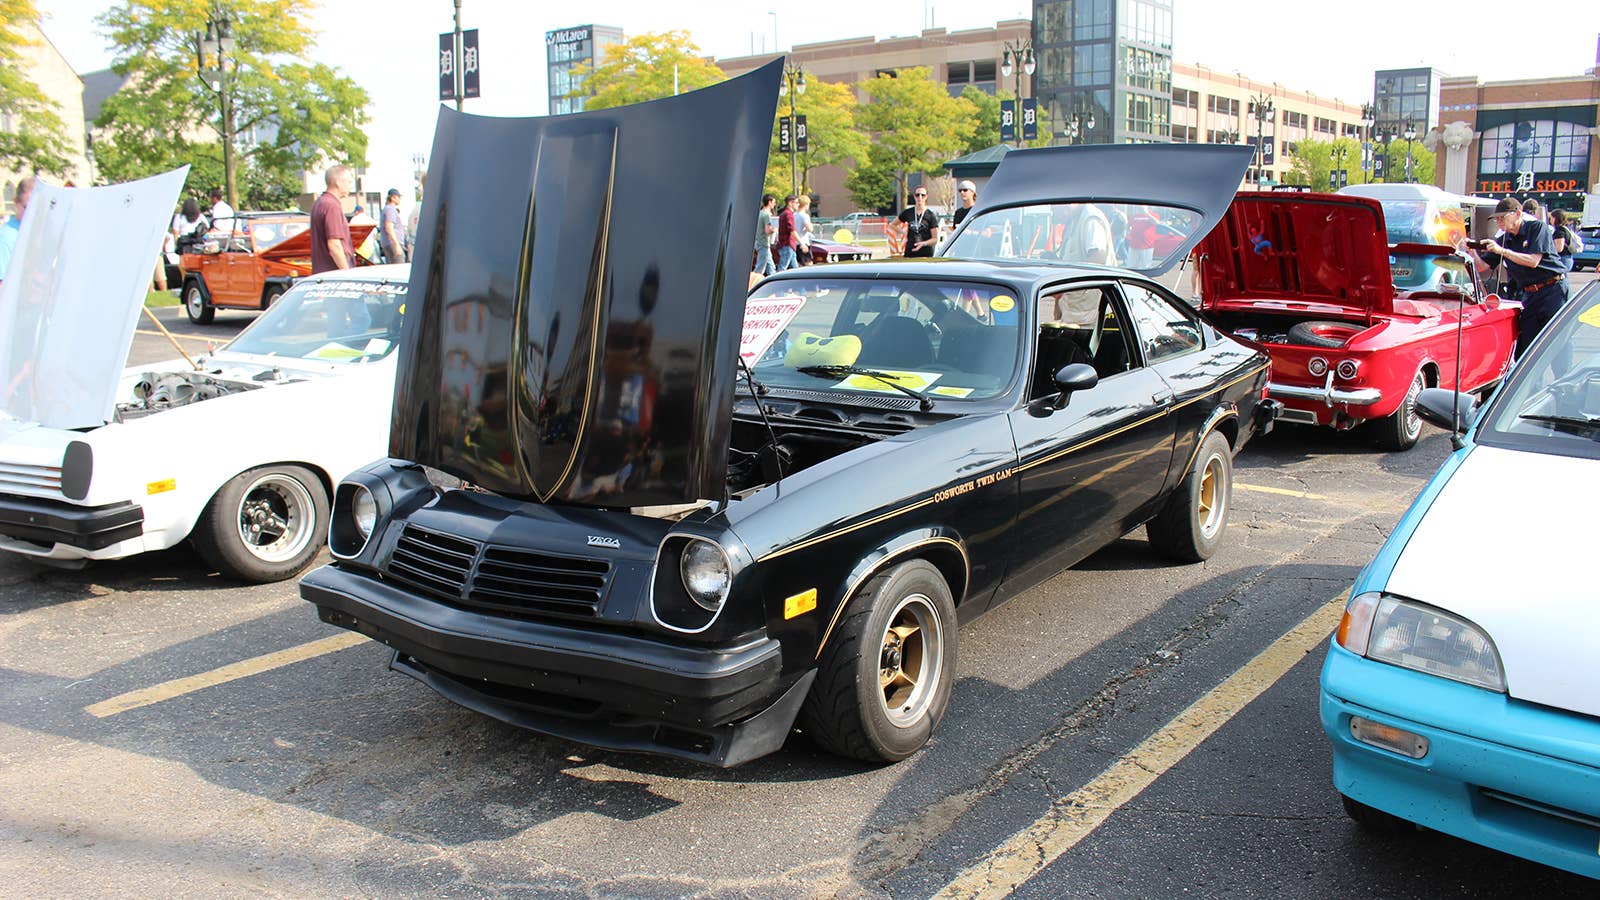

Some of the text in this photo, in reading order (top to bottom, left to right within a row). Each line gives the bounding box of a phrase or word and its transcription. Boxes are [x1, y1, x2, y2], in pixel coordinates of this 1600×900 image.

[556, 30, 588, 43] McLaren
[781, 130, 789, 145] 3
[1480, 181, 1511, 193] THE
[1536, 179, 1577, 193] SHOP
[379, 284, 409, 295] PLU
[745, 304, 797, 315] OSWORTH
[743, 319, 780, 329] ARKING
[934, 468, 1012, 503] COSWORTH TWIN CAM
[586, 535, 621, 549] VEGA
